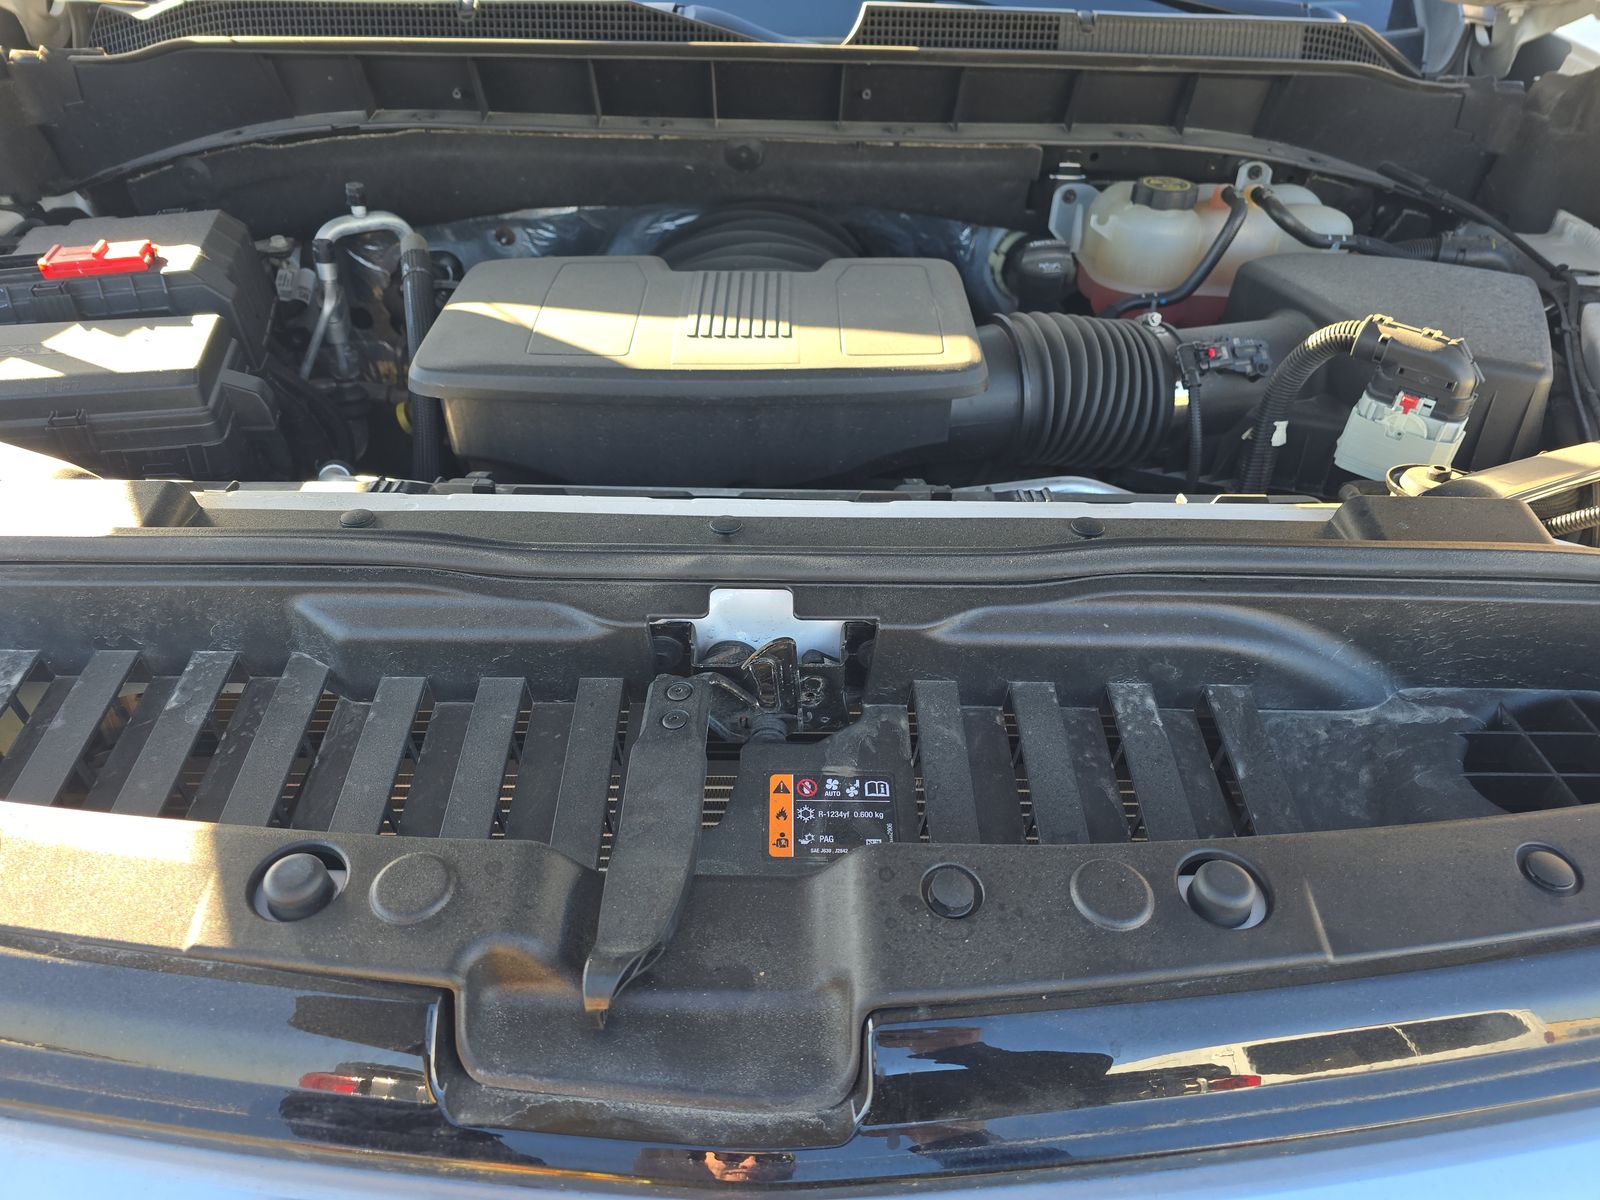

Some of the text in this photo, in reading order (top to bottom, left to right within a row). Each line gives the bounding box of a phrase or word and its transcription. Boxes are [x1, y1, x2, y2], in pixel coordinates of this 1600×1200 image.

[818, 811, 850, 819] R-1234yf
[875, 811, 884, 819] kg
[819, 835, 834, 843] PAG
